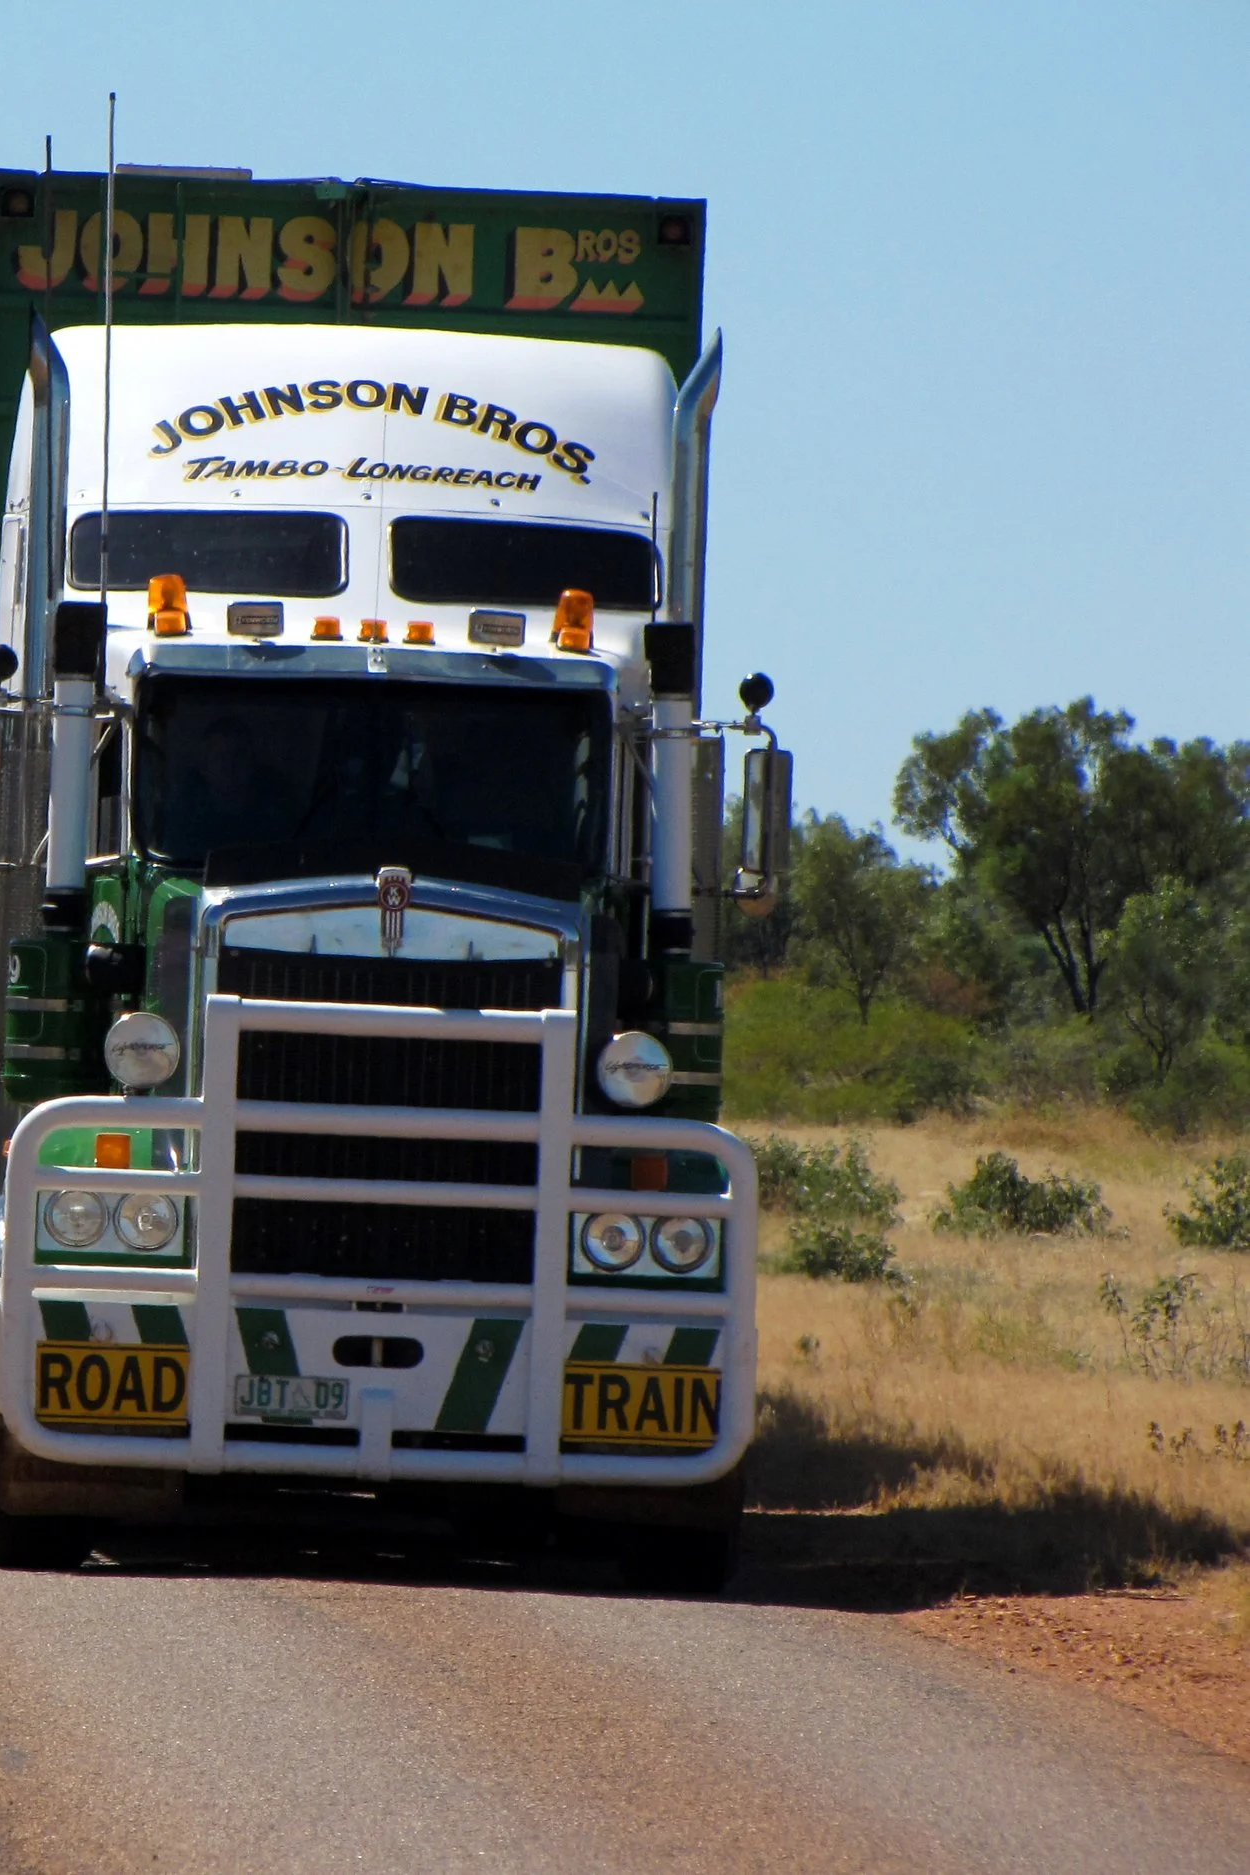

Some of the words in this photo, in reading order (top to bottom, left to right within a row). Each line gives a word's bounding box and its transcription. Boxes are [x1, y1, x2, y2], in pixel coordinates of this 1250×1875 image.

[17, 209, 476, 307] JOHNSON
[150, 379, 429, 457] JOHNSON
[39, 1353, 186, 1412] ROAD
[565, 1373, 721, 1435] TRAIN
